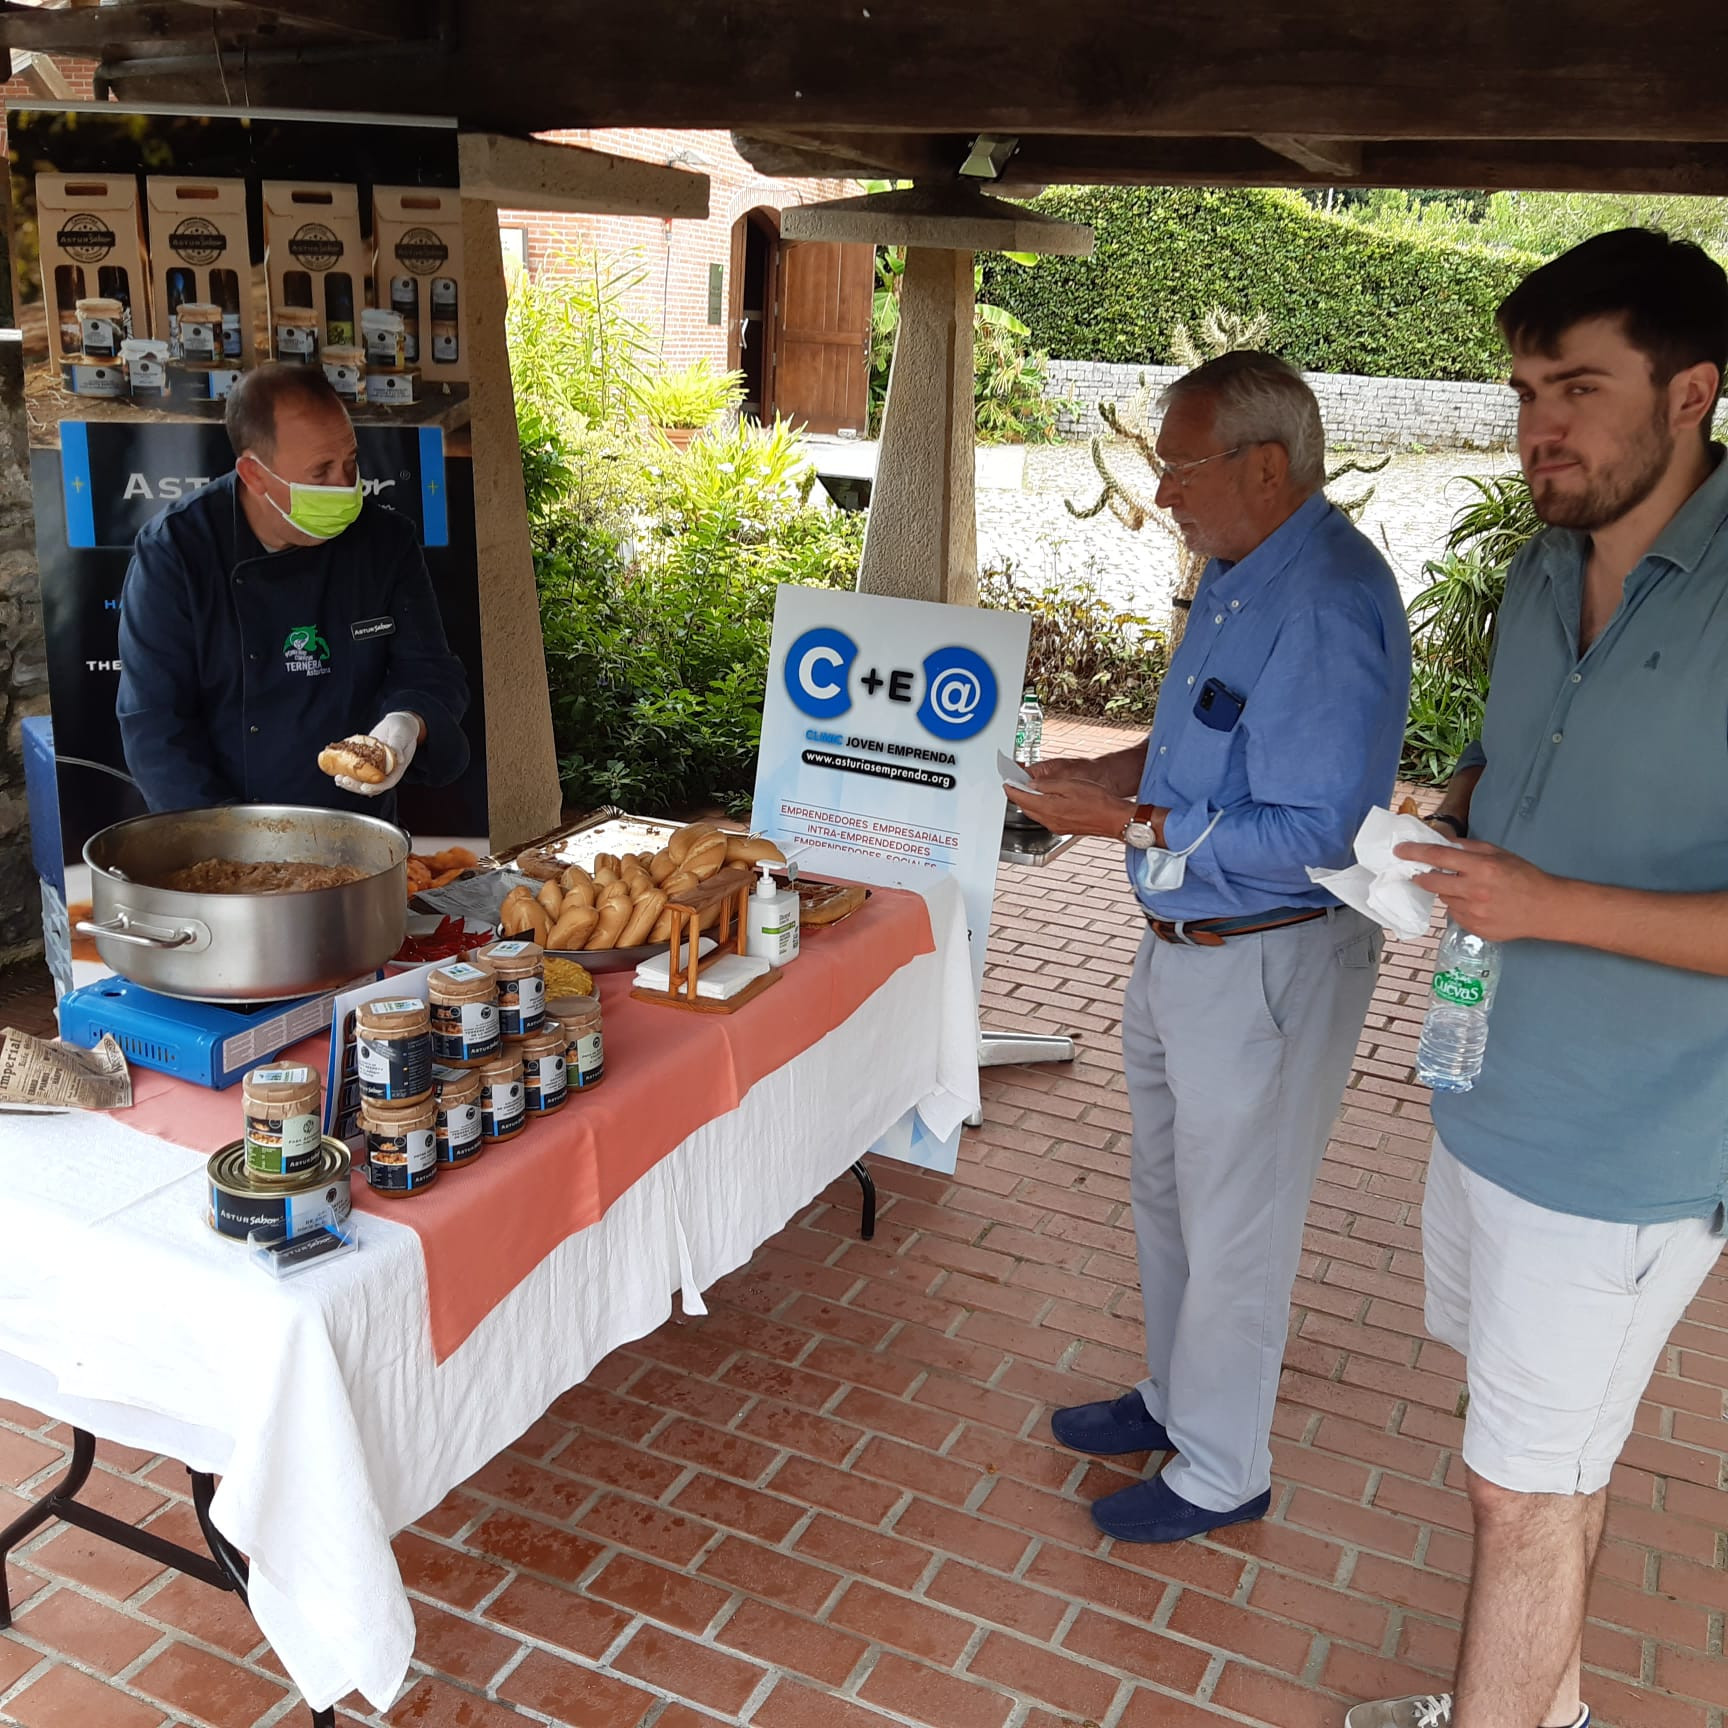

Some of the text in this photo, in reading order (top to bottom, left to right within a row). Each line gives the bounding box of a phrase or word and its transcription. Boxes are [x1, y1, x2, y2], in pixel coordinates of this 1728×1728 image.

[285, 660, 322, 673] TERNERA
[805, 729, 956, 766] CLINIC JOVEN EMPRENDA
[806, 751, 951, 788] www.asturiasemprenda.org
[781, 804, 959, 847] EMPRENDEDORES EMPRESARIALES
[807, 824, 931, 856] INTRA-EMPRENDEDORES
[1434, 974, 1479, 1000] Cuevas
